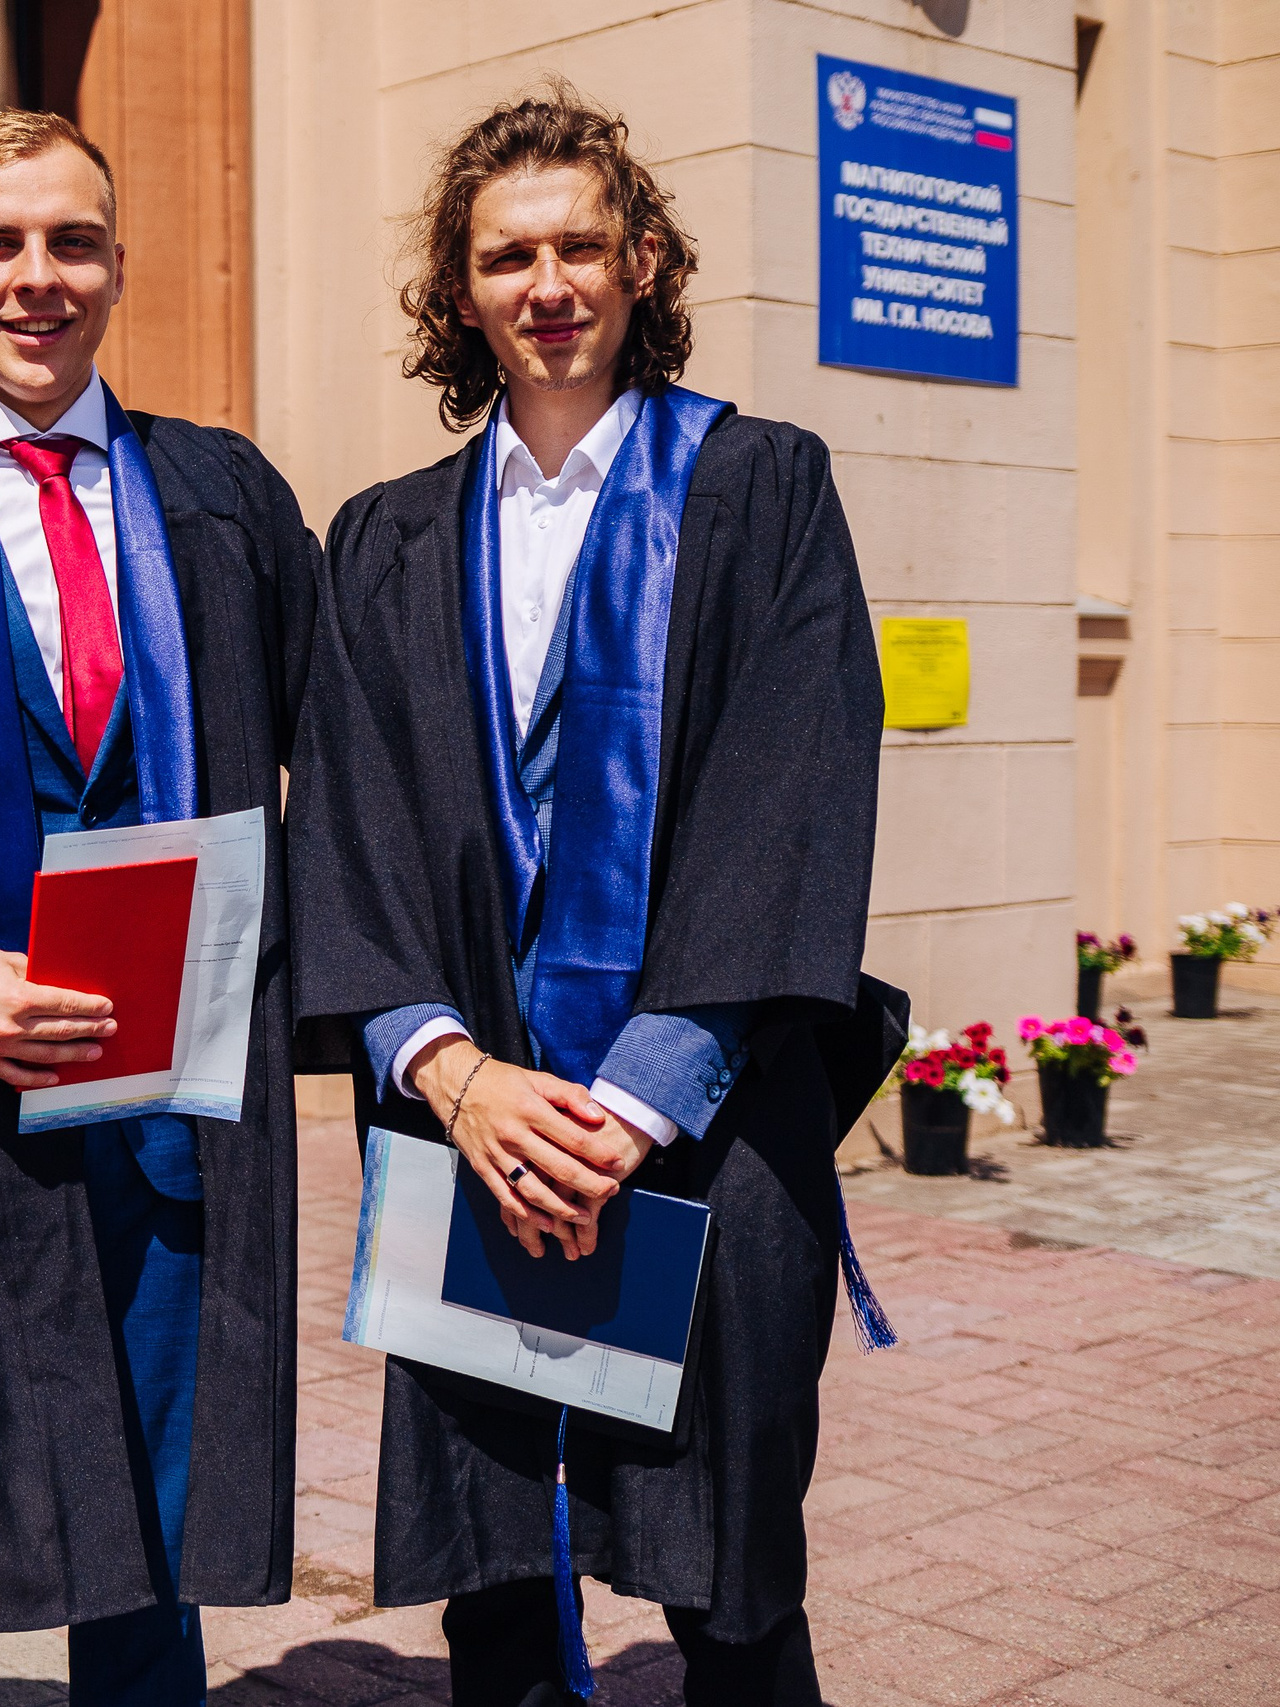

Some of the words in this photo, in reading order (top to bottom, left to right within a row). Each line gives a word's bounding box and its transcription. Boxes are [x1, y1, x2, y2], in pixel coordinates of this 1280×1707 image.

[840, 161, 1002, 213] МАГНИТОГОРСКИЙ
[833, 193, 1009, 247] ГОСУДАРСТВЕННЫЙ
[860, 231, 987, 275] ТЕХНИЧЕСКИЙ
[861, 265, 987, 307] УНИВЕРСИТЕТ
